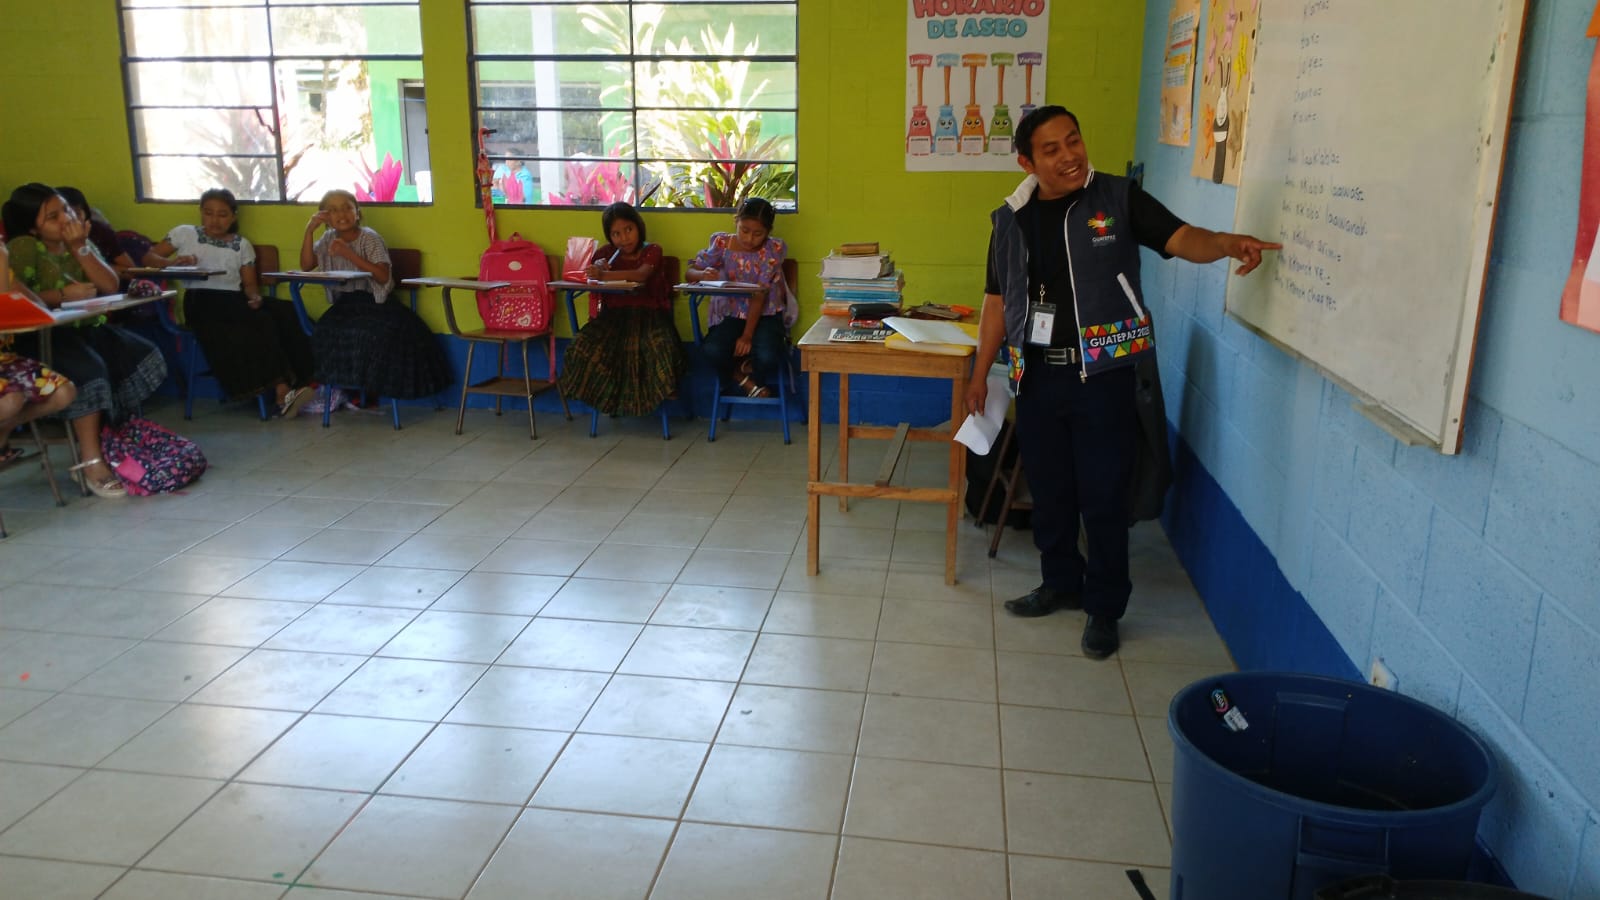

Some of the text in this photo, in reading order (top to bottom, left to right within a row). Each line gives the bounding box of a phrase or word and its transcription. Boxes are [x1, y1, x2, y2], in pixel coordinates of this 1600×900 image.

[915, 0, 1044, 17] HORARIO
[927, 19, 1027, 39] DE ASEO
[1090, 329, 1136, 347] GUATEPAZ
